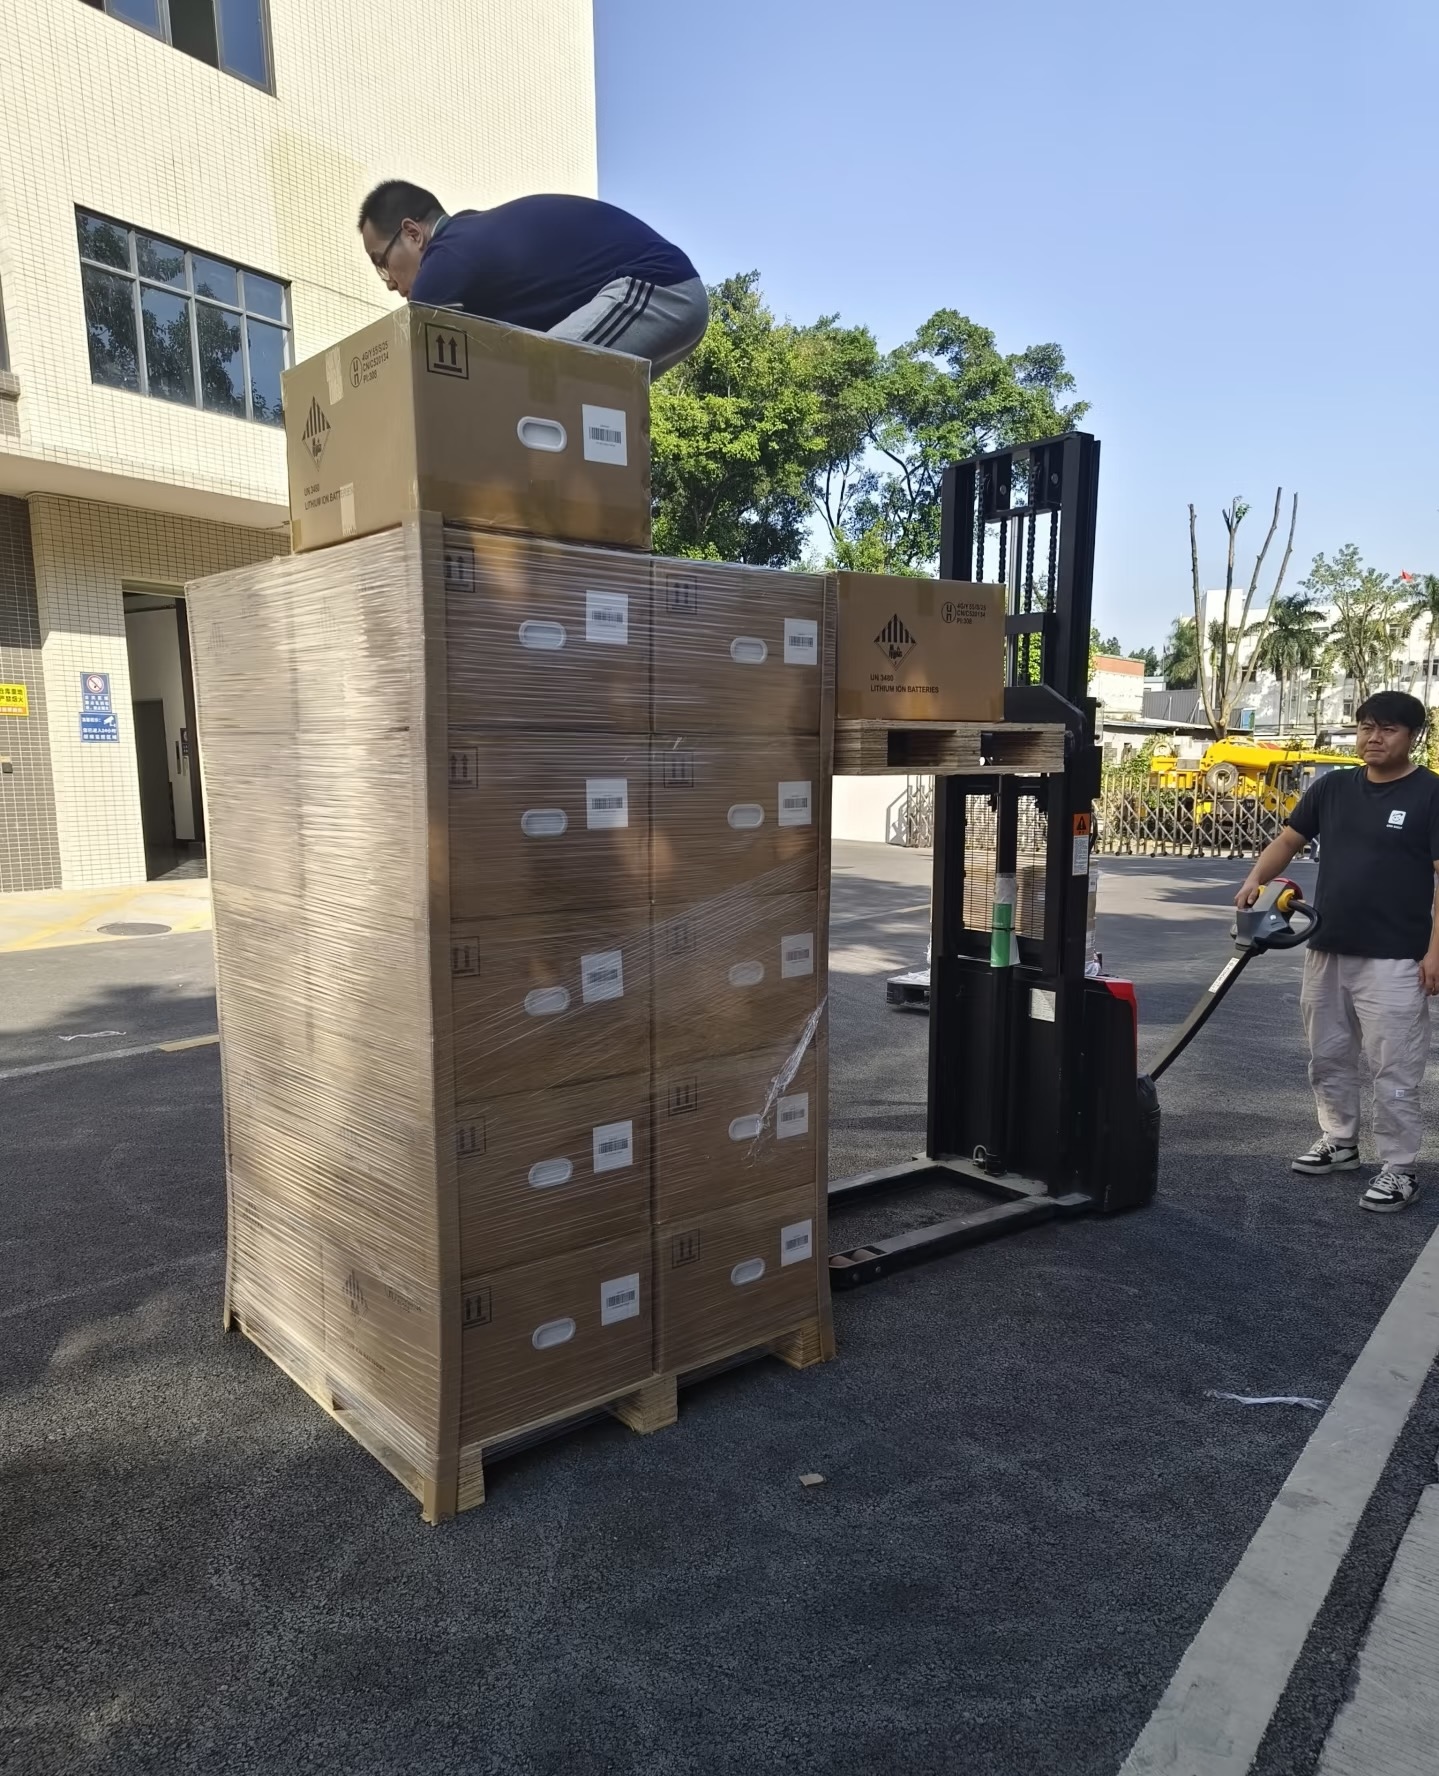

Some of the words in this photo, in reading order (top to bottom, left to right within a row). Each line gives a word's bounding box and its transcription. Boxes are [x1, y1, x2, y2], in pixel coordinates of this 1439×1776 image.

[870, 684, 894, 692] LITHIUM
[895, 685, 906, 693] ION
[907, 685, 939, 693] BATTERIES
